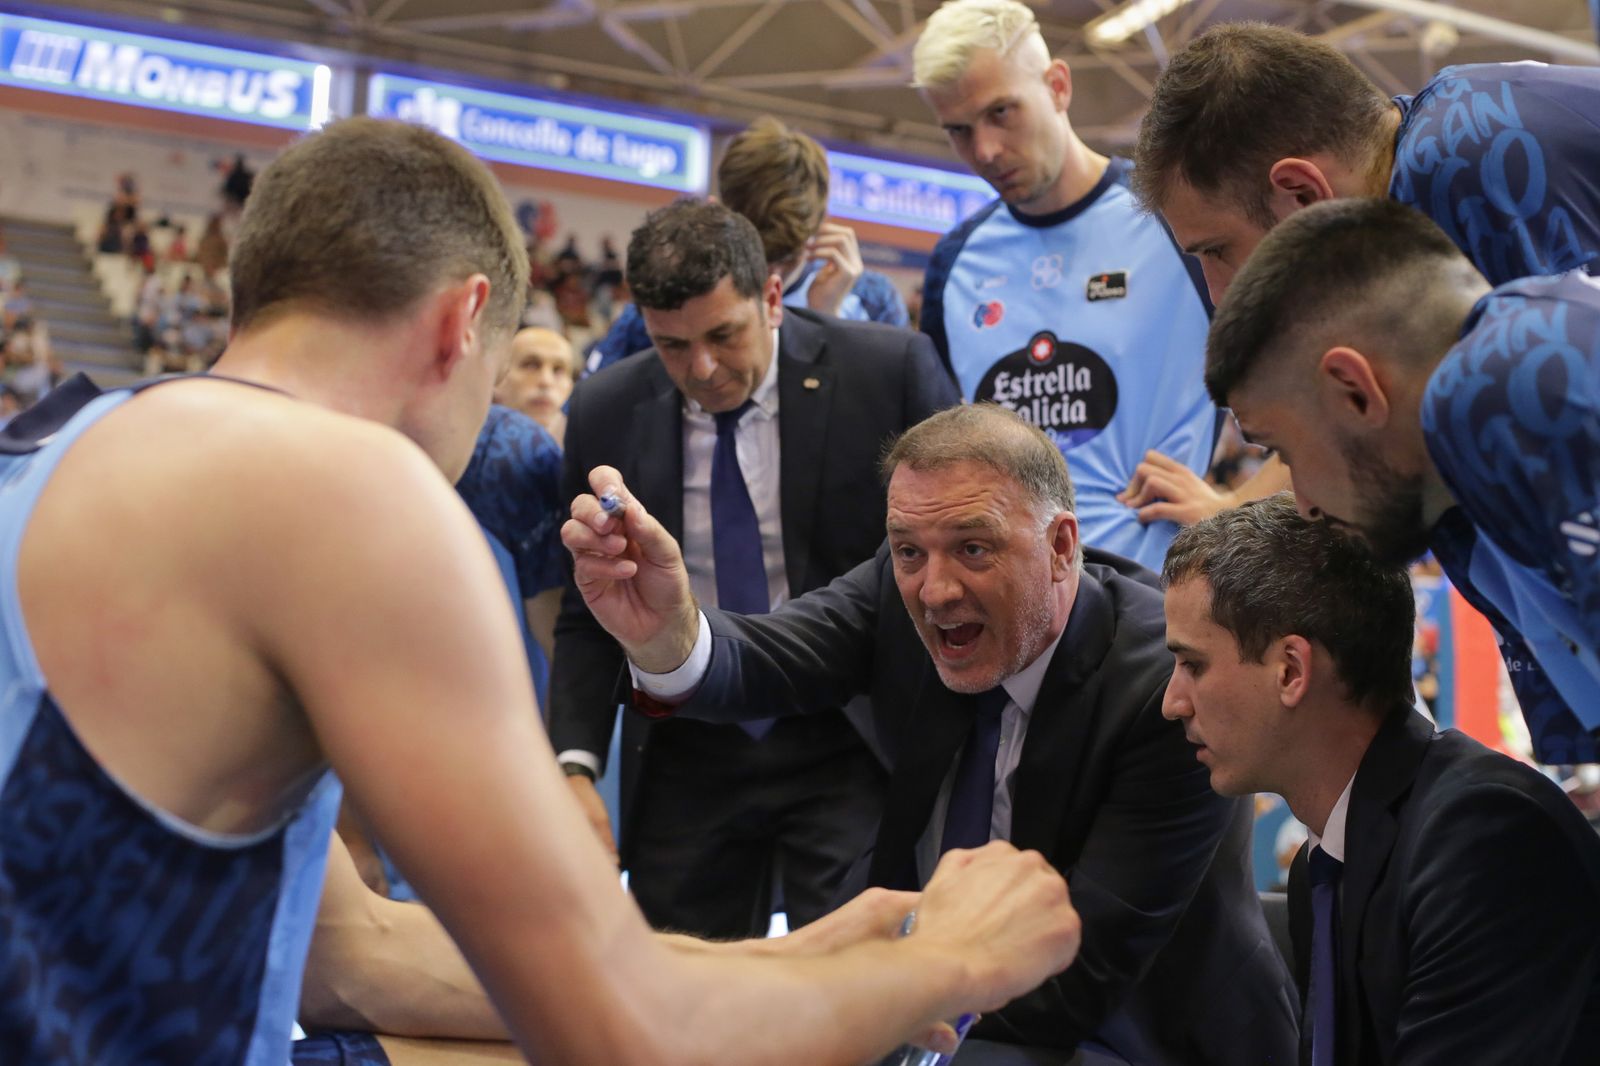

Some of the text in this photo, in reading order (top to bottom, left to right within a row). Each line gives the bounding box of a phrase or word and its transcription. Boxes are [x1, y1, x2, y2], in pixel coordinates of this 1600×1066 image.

[574, 125, 610, 162] de
[611, 132, 677, 178] Lugo
[992, 362, 1092, 401] Estrella
